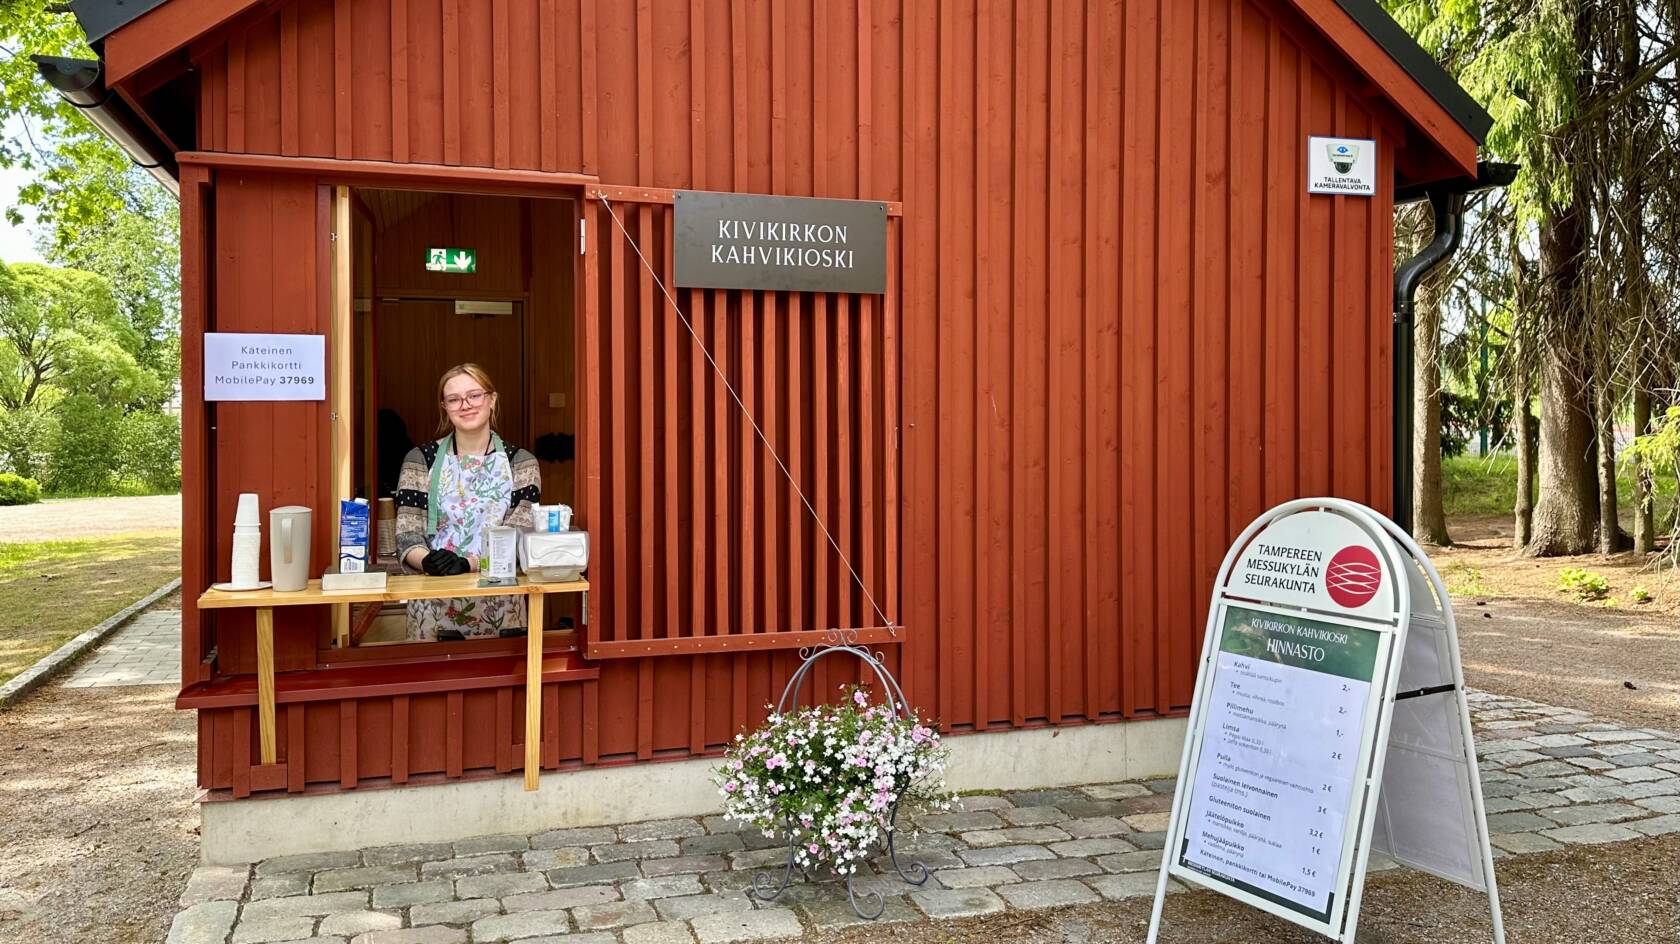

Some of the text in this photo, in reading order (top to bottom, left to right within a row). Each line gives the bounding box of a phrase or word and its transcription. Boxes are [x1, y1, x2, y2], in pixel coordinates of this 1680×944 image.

[1314, 182, 1370, 191] KAMERAVALVONTA
[1324, 176, 1361, 184] TALLENTAVA
[719, 220, 847, 244] KIVIKIRKON
[711, 244, 854, 268] KAHVIKIOSKI
[231, 360, 302, 370] Pankkikortti
[215, 375, 315, 386] MobilePay 37969
[1258, 544, 1322, 562] TAMPEREEN
[1246, 558, 1320, 578] MESSUKYLÄN
[1245, 573, 1316, 594] SEURAKUNTA
[1251, 617, 1348, 645] KIVIKIRKON KAHVIKIOSKI
[1266, 638, 1325, 662] HINNASTO
[1234, 661, 1250, 670] Kahvi
[1230, 681, 1241, 689] Tee
[1226, 702, 1254, 714] Pillimehu
[1222, 722, 1240, 732] Limsa
[1216, 752, 1231, 762] Pulla
[1213, 772, 1240, 786] Suolainen
[1242, 782, 1278, 799] leivonnainen
[1209, 796, 1242, 811] Gluteeniton
[1242, 807, 1271, 821] suolainen
[1205, 810, 1244, 828] Jäätelöpuikko
[1202, 831, 1244, 851] Mehujääpuikko
[1302, 868, 1311, 876] 1,5
[1225, 860, 1258, 876] pankkikortti
[1268, 874, 1297, 891] MobilePay
[1298, 885, 1316, 897] 37969
